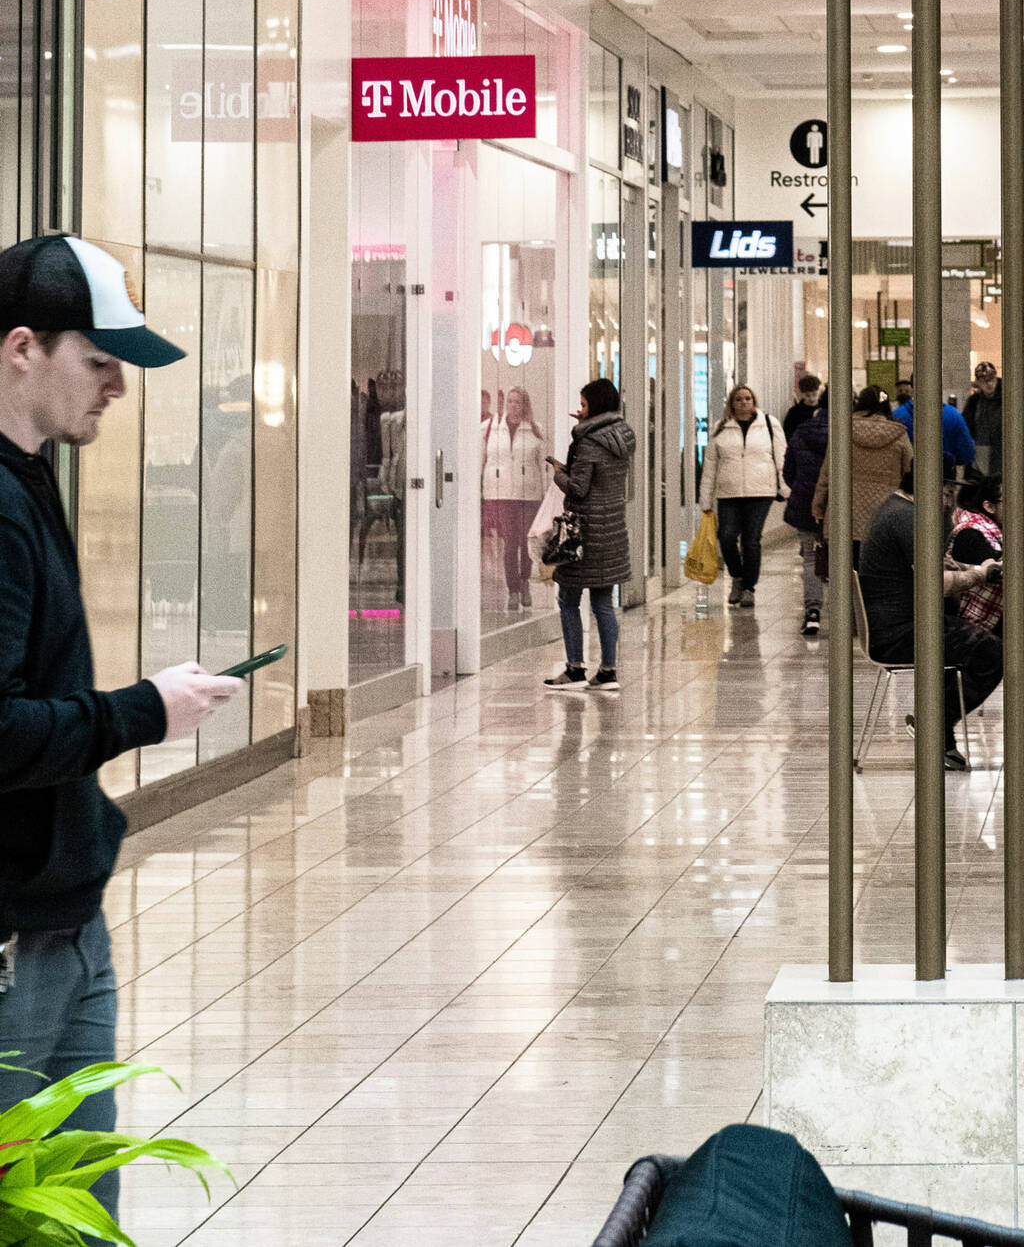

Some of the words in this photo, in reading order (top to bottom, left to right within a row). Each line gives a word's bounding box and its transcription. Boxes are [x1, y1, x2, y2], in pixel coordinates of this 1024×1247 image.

[361, 80, 393, 118] T
[399, 79, 527, 117] Mobile
[709, 230, 777, 259] Lids
